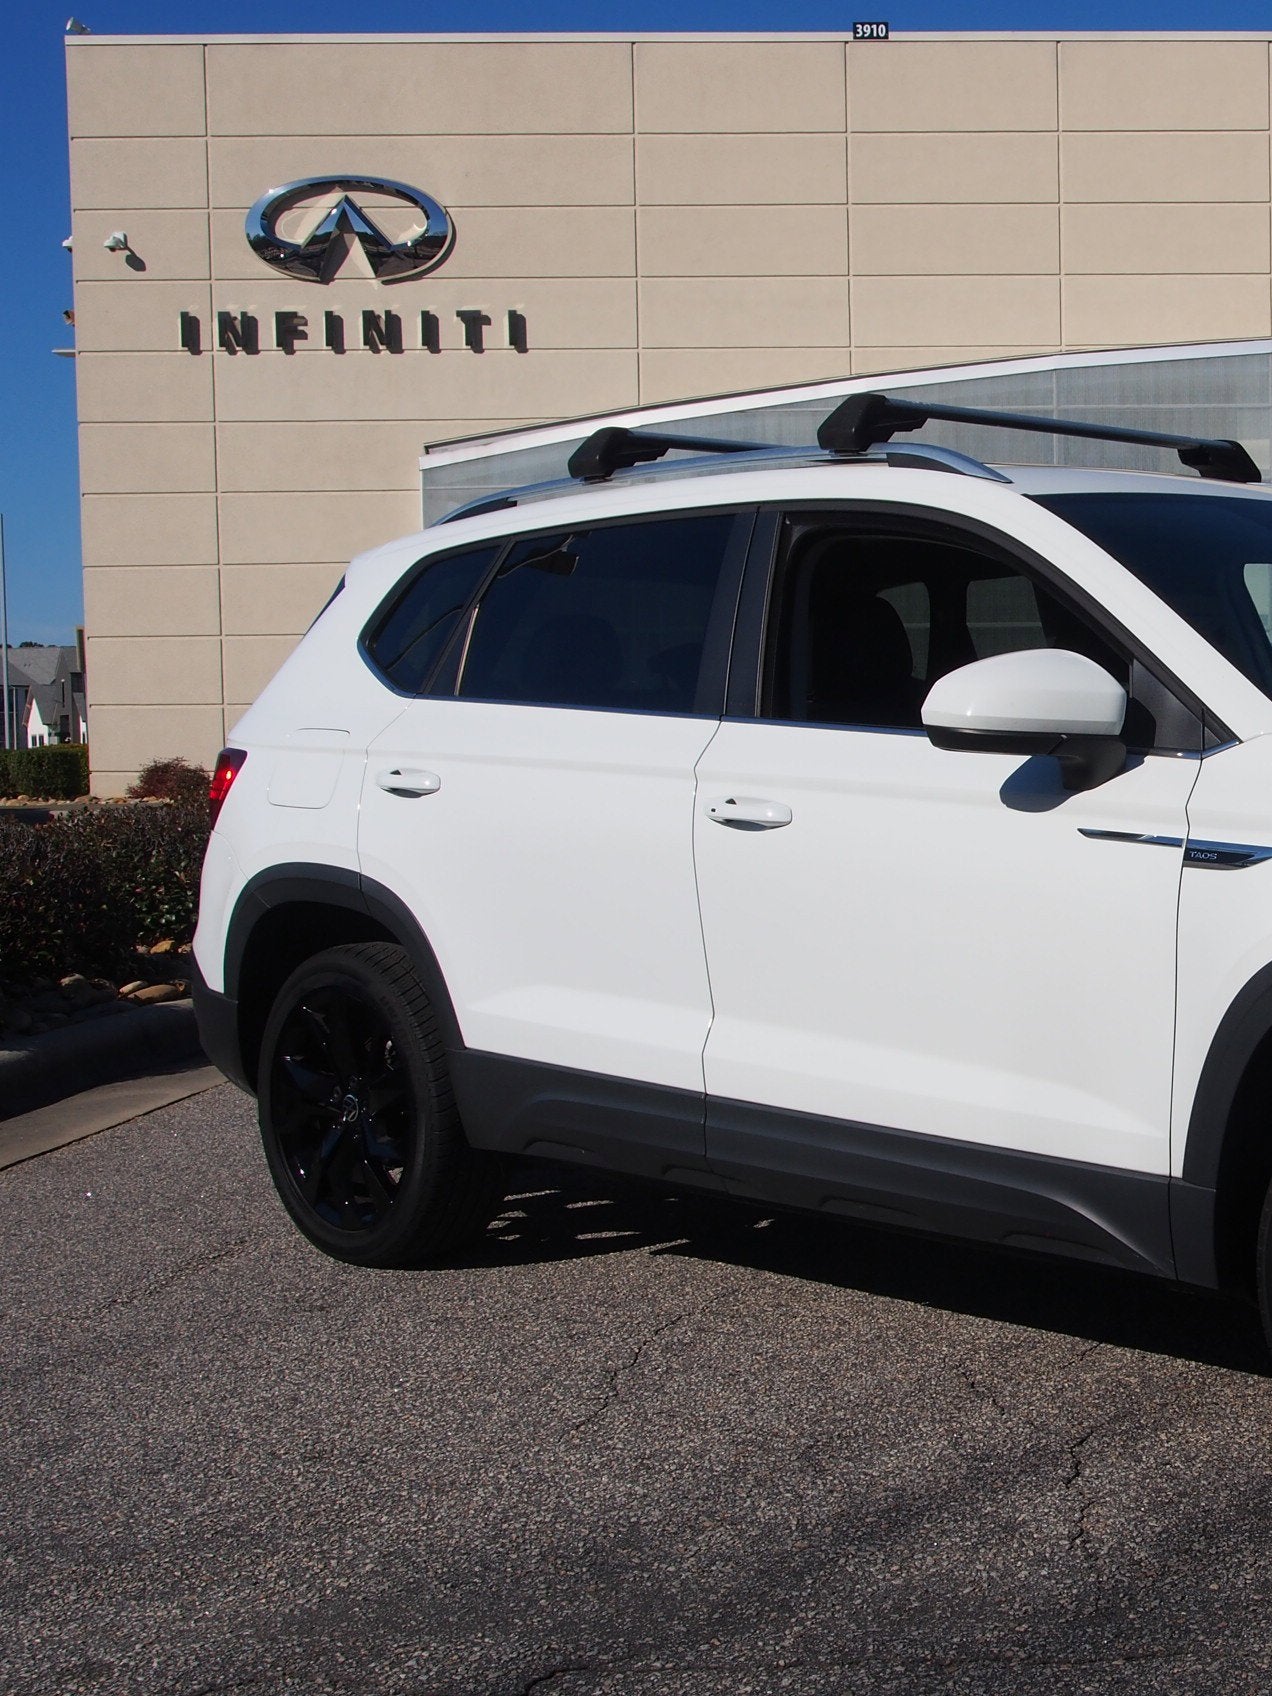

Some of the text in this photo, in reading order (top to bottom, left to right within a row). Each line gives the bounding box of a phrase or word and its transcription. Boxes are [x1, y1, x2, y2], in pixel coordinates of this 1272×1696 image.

[856, 24, 886, 37] 3910
[179, 308, 528, 354] INFINITI
[1190, 851, 1217, 860] TAOS
